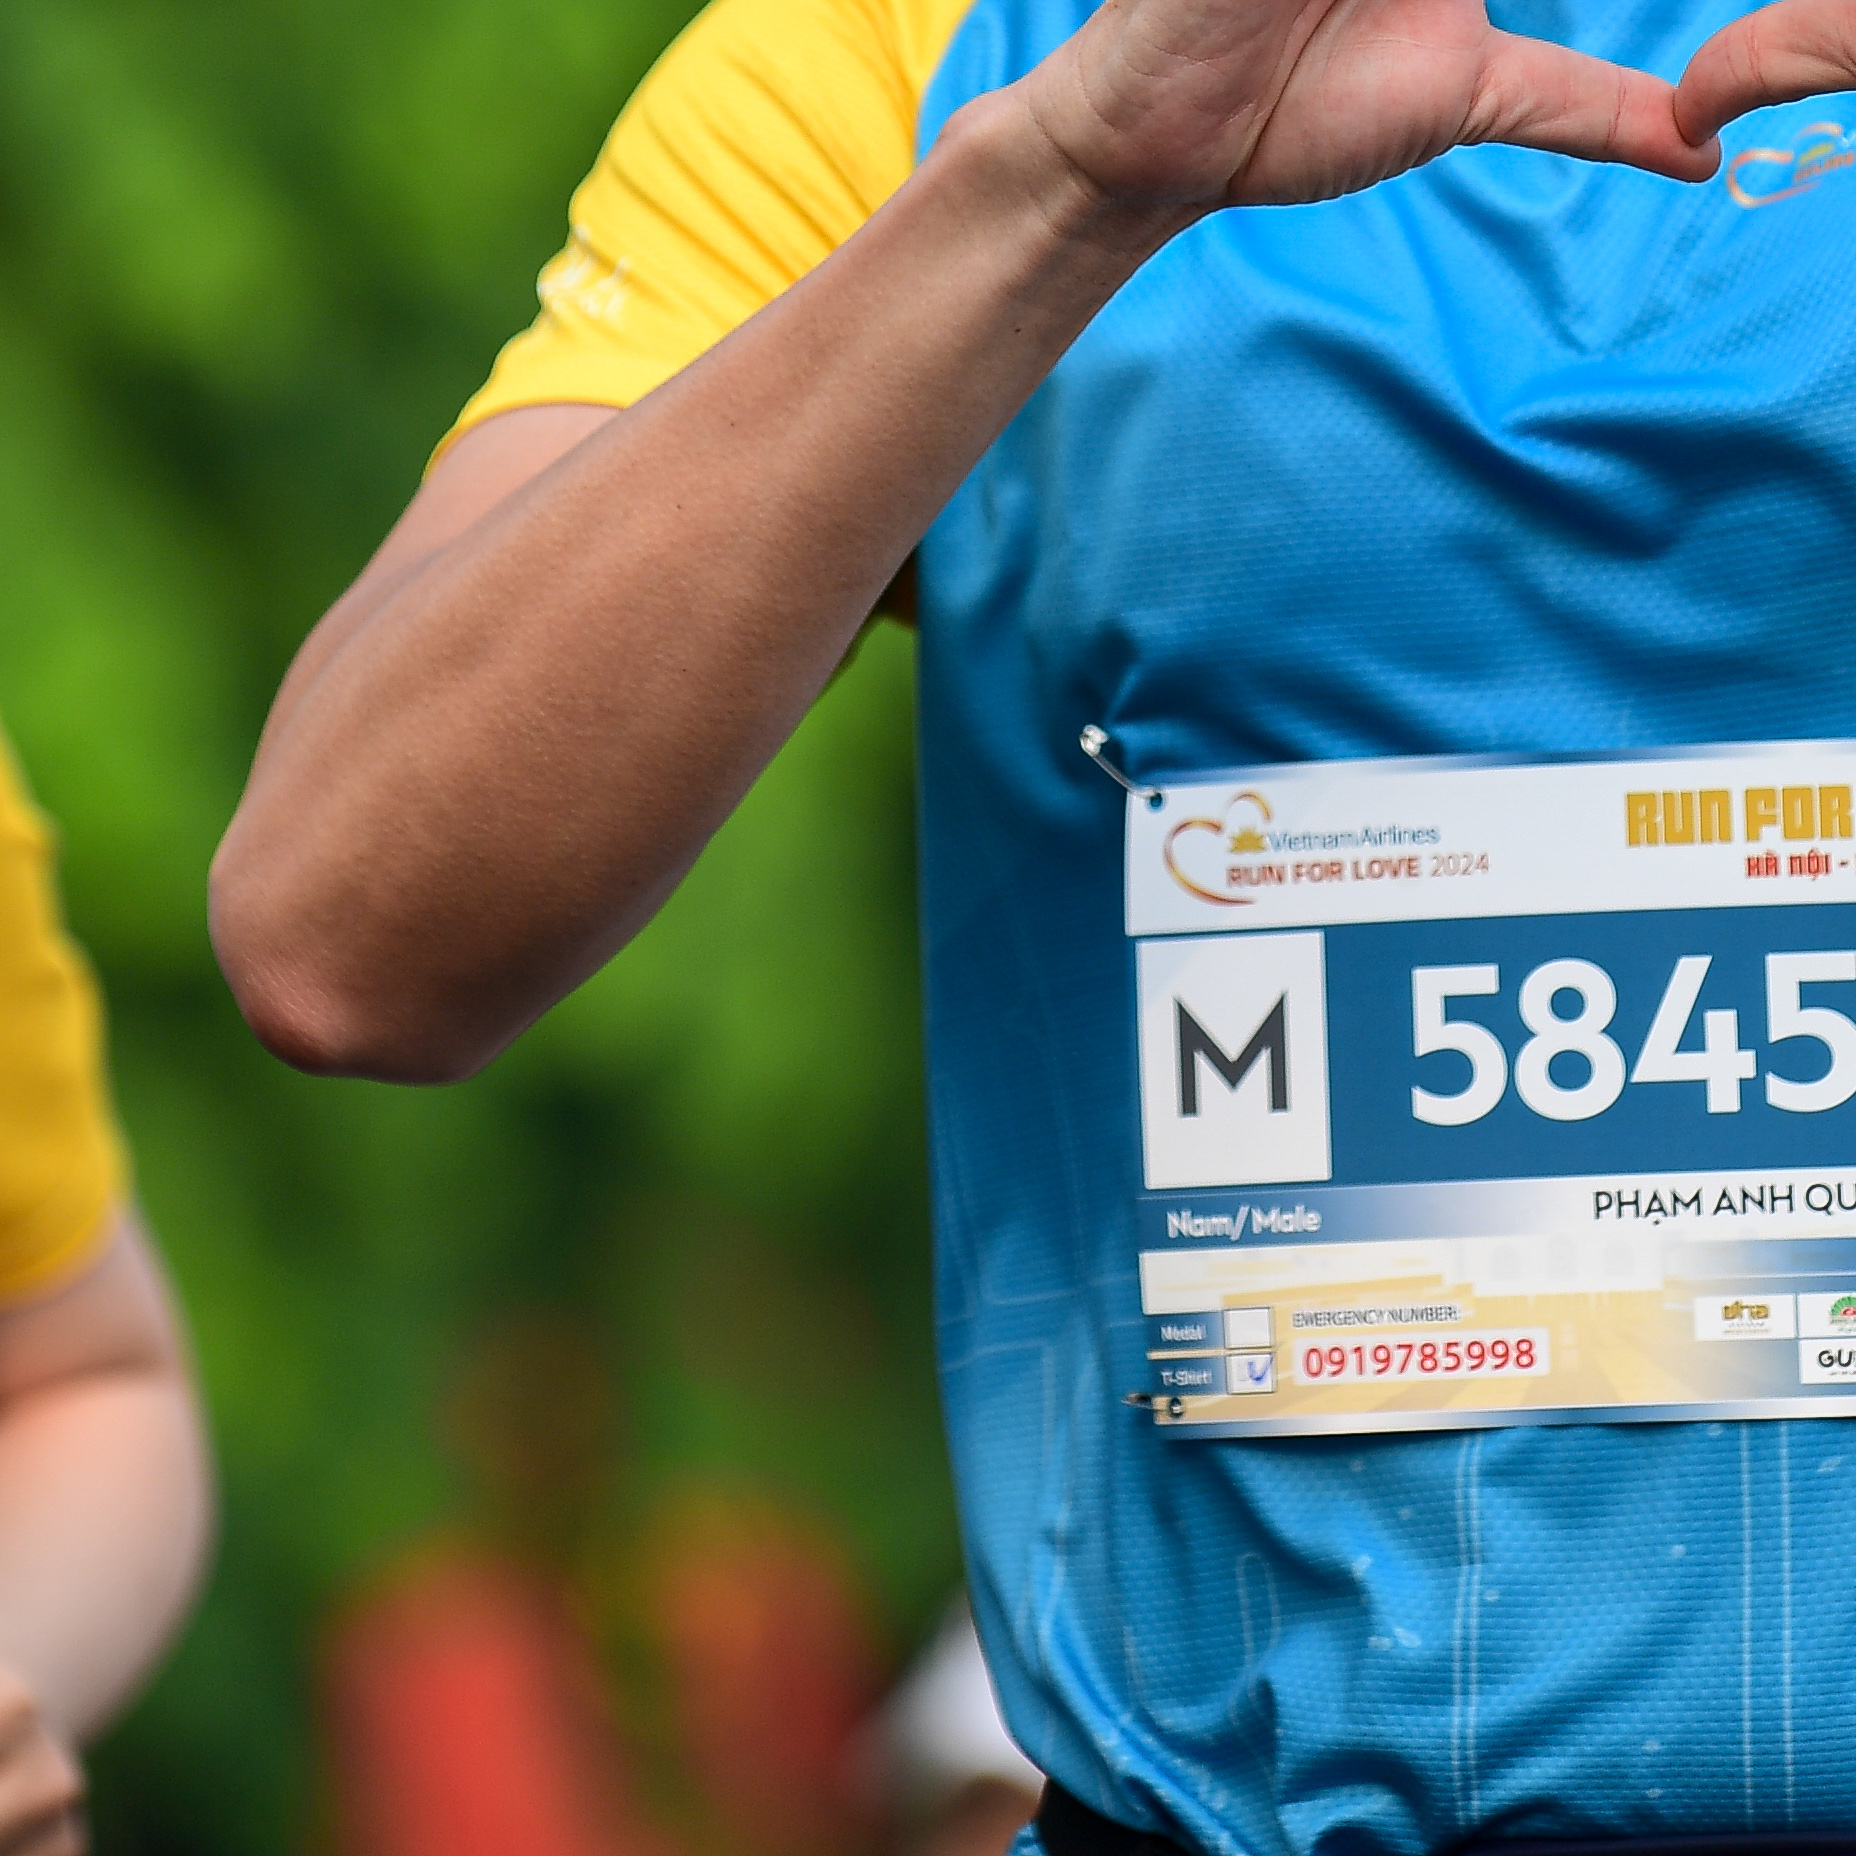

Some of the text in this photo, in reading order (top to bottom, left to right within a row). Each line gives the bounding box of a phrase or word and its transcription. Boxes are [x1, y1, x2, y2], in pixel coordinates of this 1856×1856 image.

[1627, 789, 1732, 845] RUN
[1745, 784, 1854, 842] FOR
[1269, 823, 1440, 851] Vietnam Airlines
[1227, 852, 1490, 887] RUN FOR LOVE 2024
[1176, 992, 1292, 1118] M
[1252, 1205, 1322, 1235] Male
[1593, 1186, 1703, 1225] PHẠM
[1713, 1182, 1794, 1217] ANH
[1293, 1310, 1384, 1328] EMERGENCY
[1304, 1337, 1538, 1380] 0919785998
